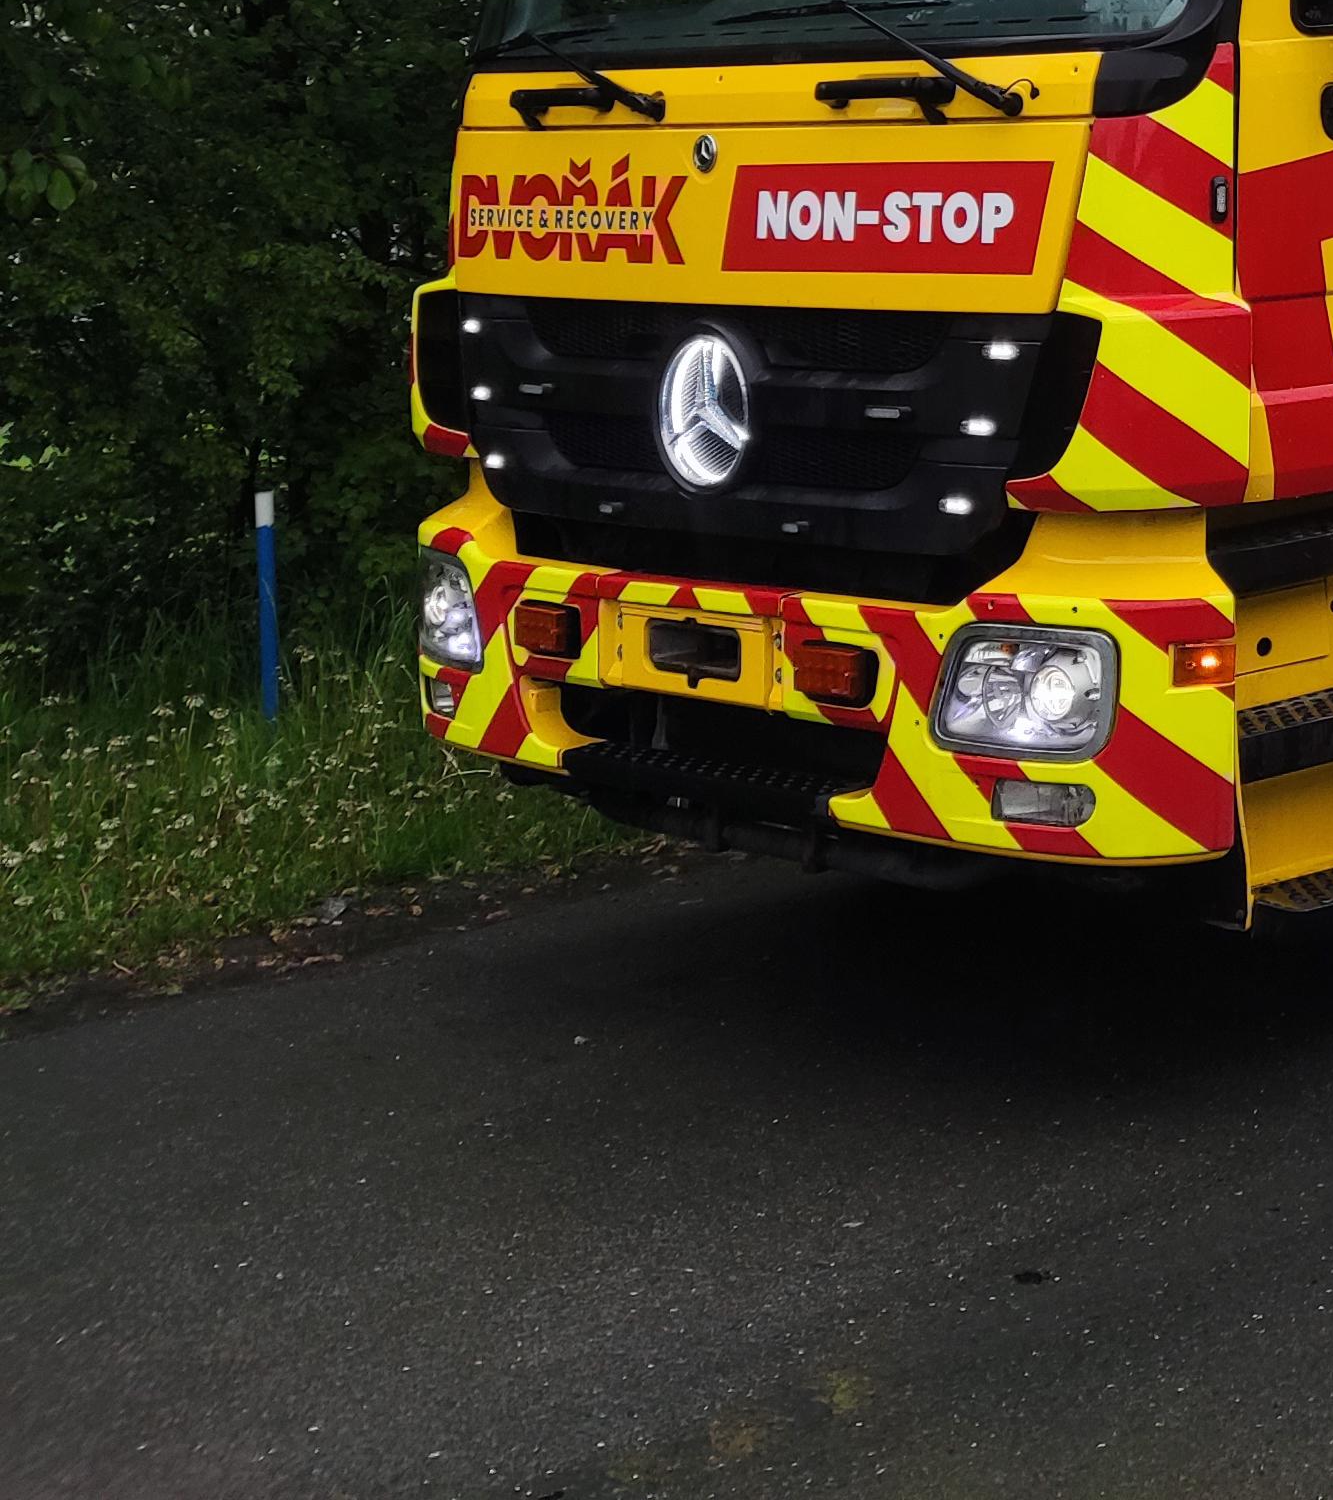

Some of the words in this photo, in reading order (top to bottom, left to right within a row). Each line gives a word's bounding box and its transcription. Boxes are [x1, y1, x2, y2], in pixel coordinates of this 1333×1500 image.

[458, 153, 689, 265] DVOŘÁK
[470, 208, 533, 228] SERVICE
[539, 209, 548, 229] &
[554, 209, 654, 231] RECOVERY
[755, 189, 1015, 244] NON-STOP
